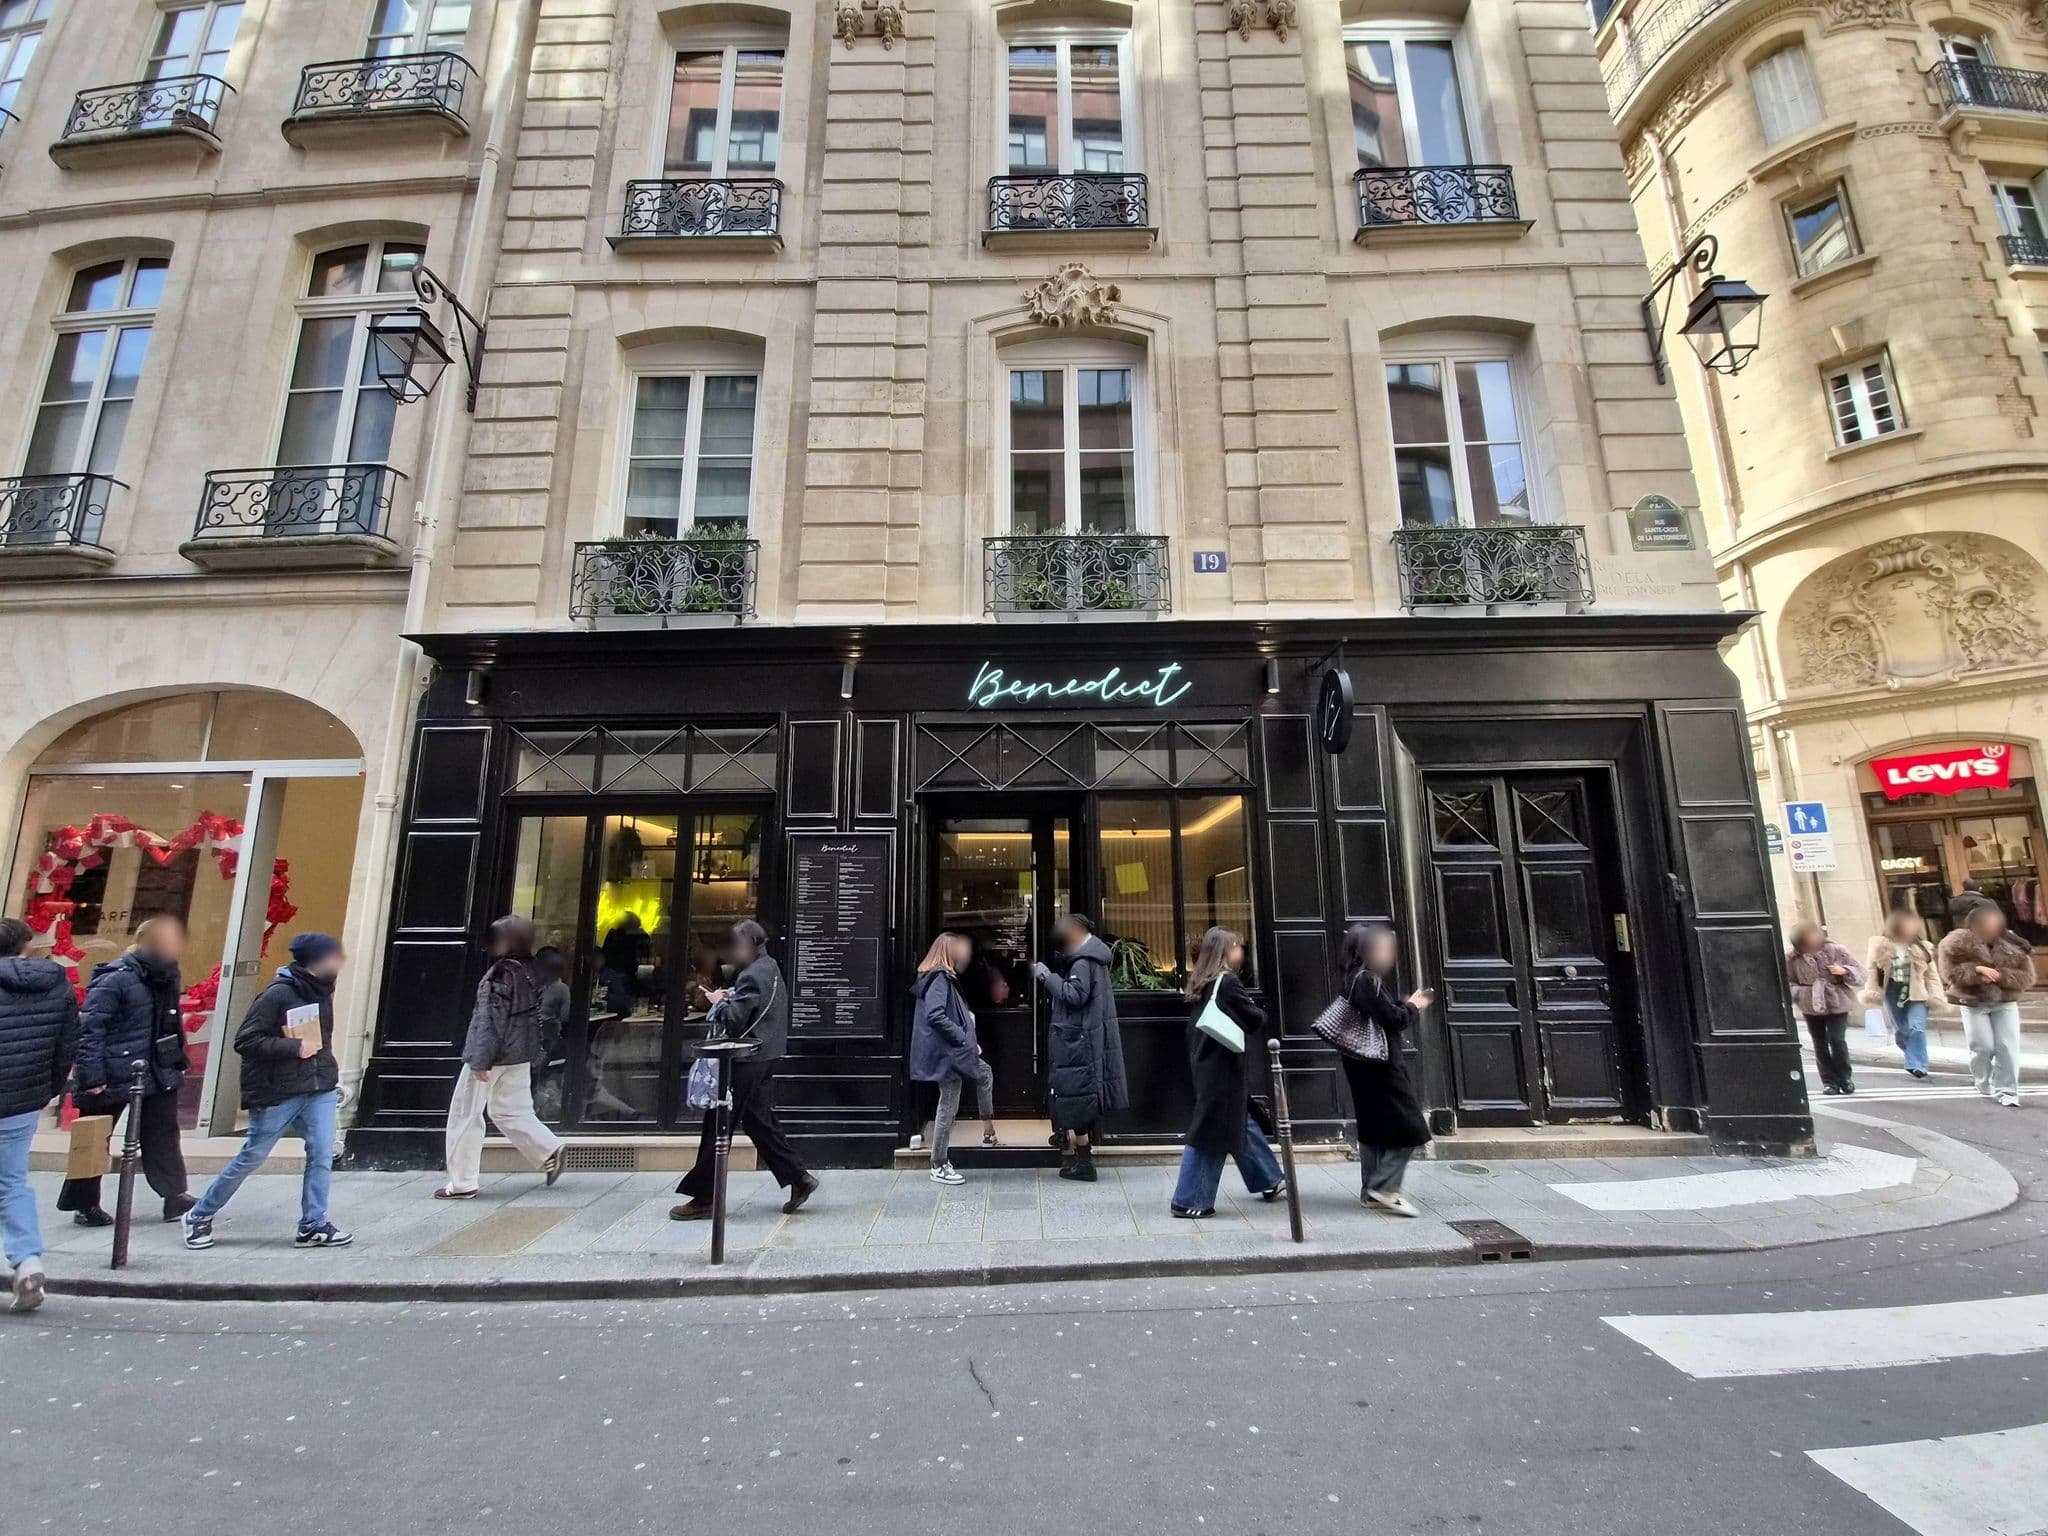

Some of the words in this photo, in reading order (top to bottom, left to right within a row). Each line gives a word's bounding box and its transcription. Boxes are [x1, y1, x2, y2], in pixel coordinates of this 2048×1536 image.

[1201, 554, 1220, 570] 19
[968, 660, 1193, 706] Benedict
[1880, 857, 1922, 870] BAGGY
